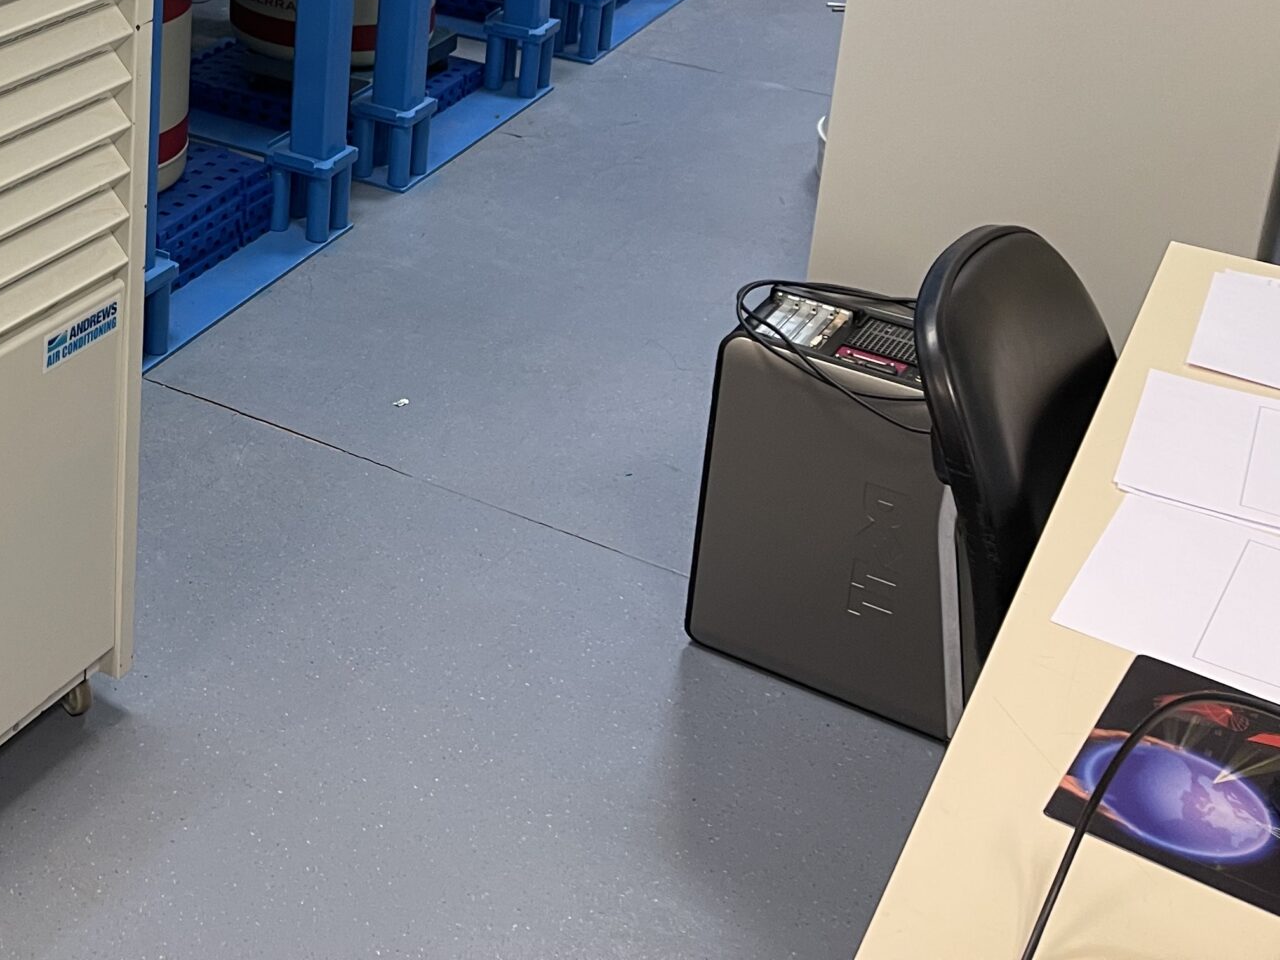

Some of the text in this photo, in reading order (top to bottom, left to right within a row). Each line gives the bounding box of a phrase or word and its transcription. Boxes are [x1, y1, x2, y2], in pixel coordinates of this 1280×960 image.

[46, 316, 117, 369] AIR CONDITIONING
[69, 301, 118, 341] ANDREWS
